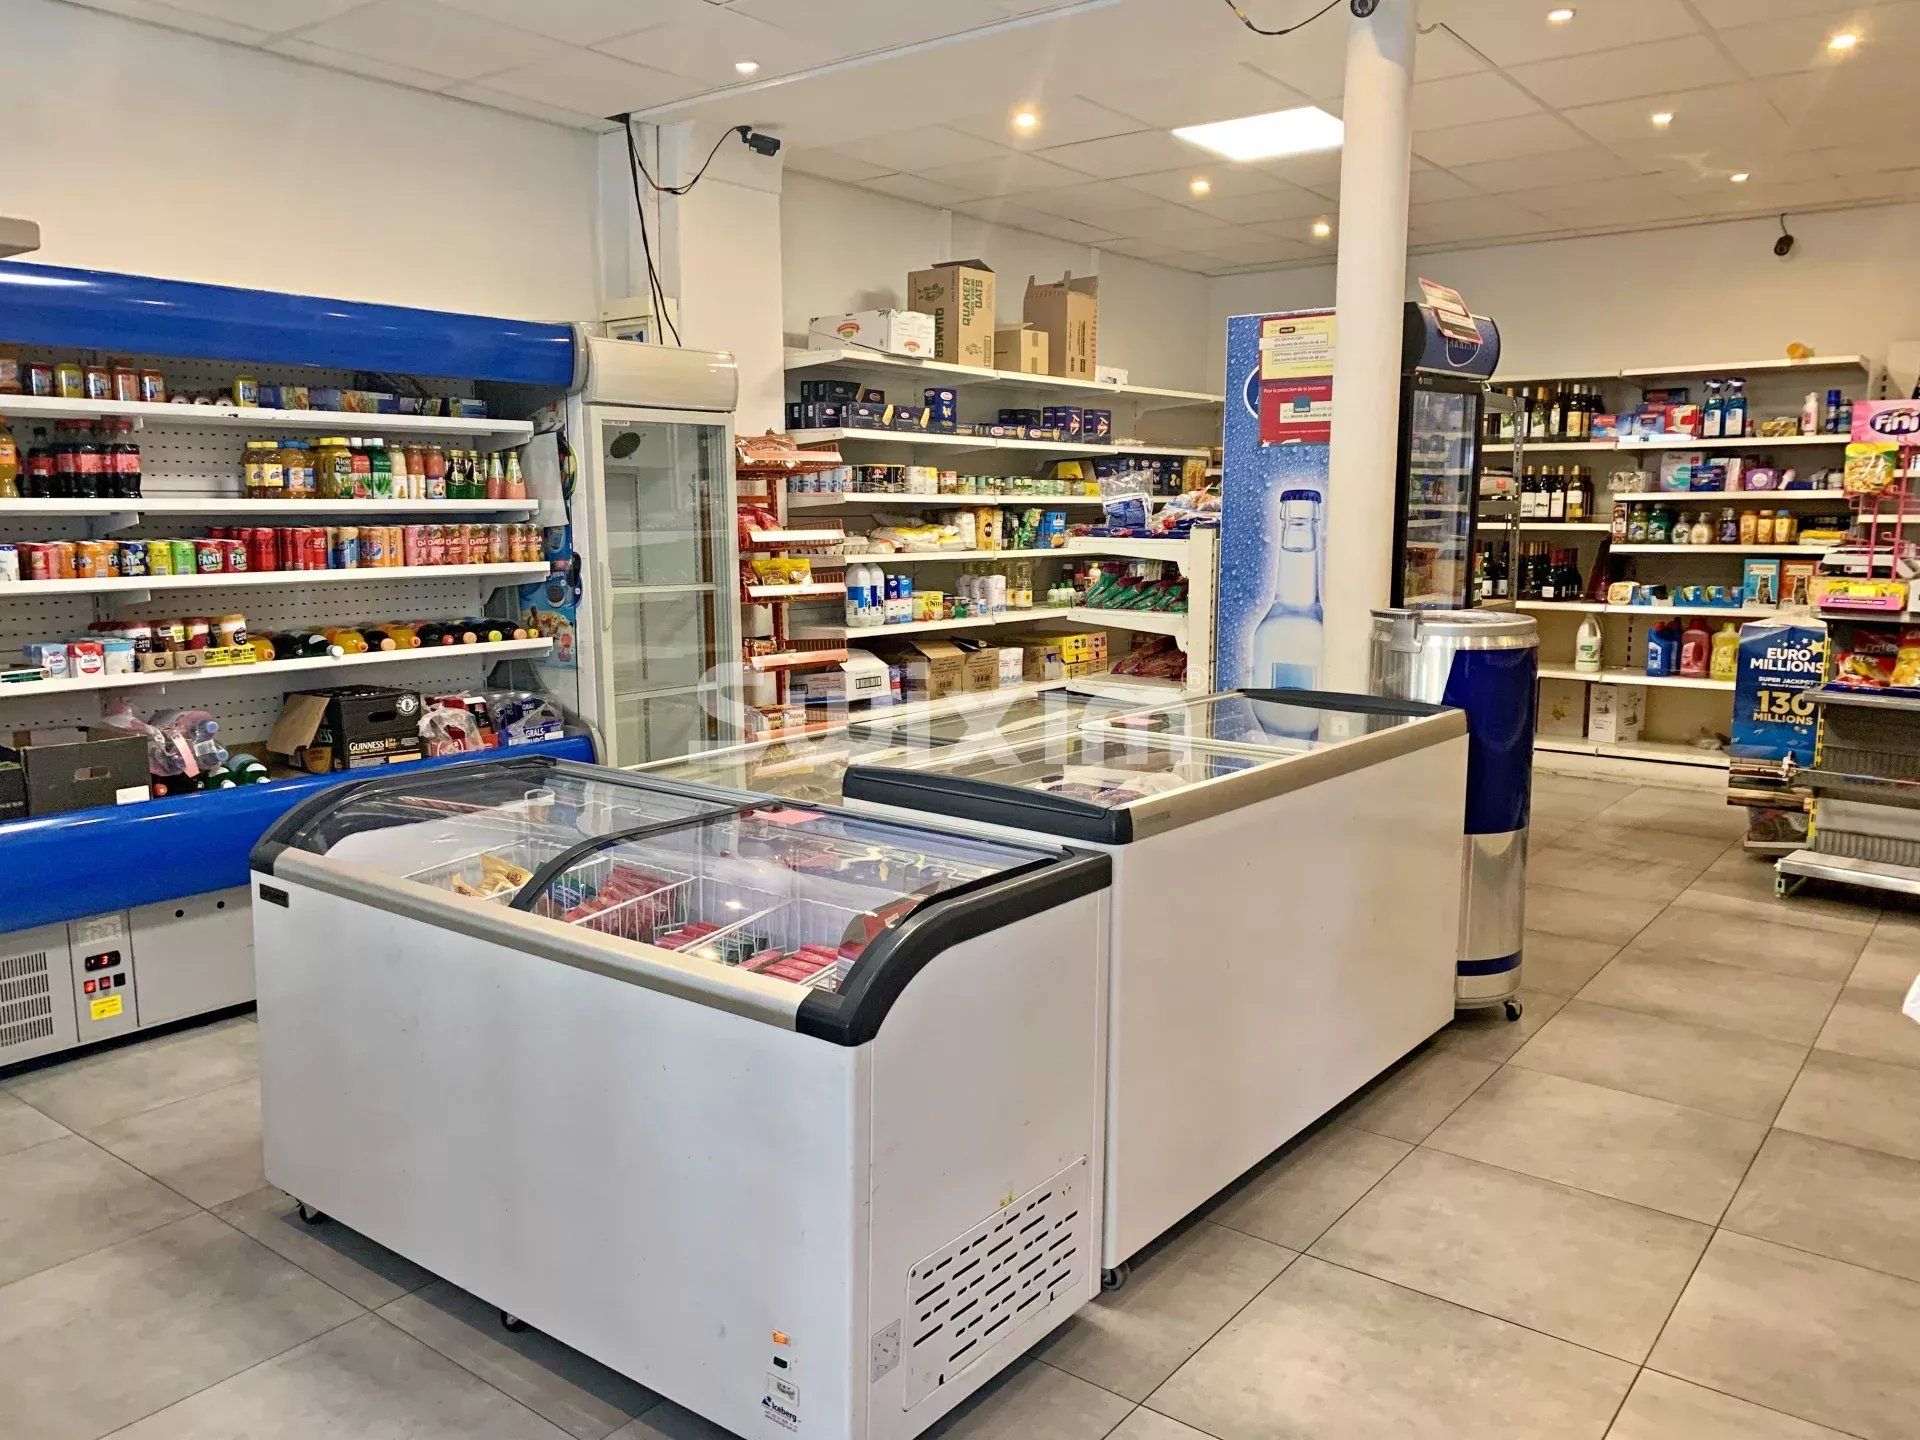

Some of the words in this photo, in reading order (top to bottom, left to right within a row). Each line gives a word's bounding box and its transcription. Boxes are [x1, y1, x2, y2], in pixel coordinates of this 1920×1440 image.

[963, 277, 972, 326] QUAKER
[975, 279, 983, 309] OATS
[335, 457, 351, 465] Aloe
[335, 464, 352, 473] King
[1766, 647, 1811, 661] EURO
[1750, 657, 1824, 674] MILLIONS
[1757, 690, 1815, 716] 130
[1753, 711, 1814, 726] MILLIONS
[349, 740, 385, 751] GUINNESS
